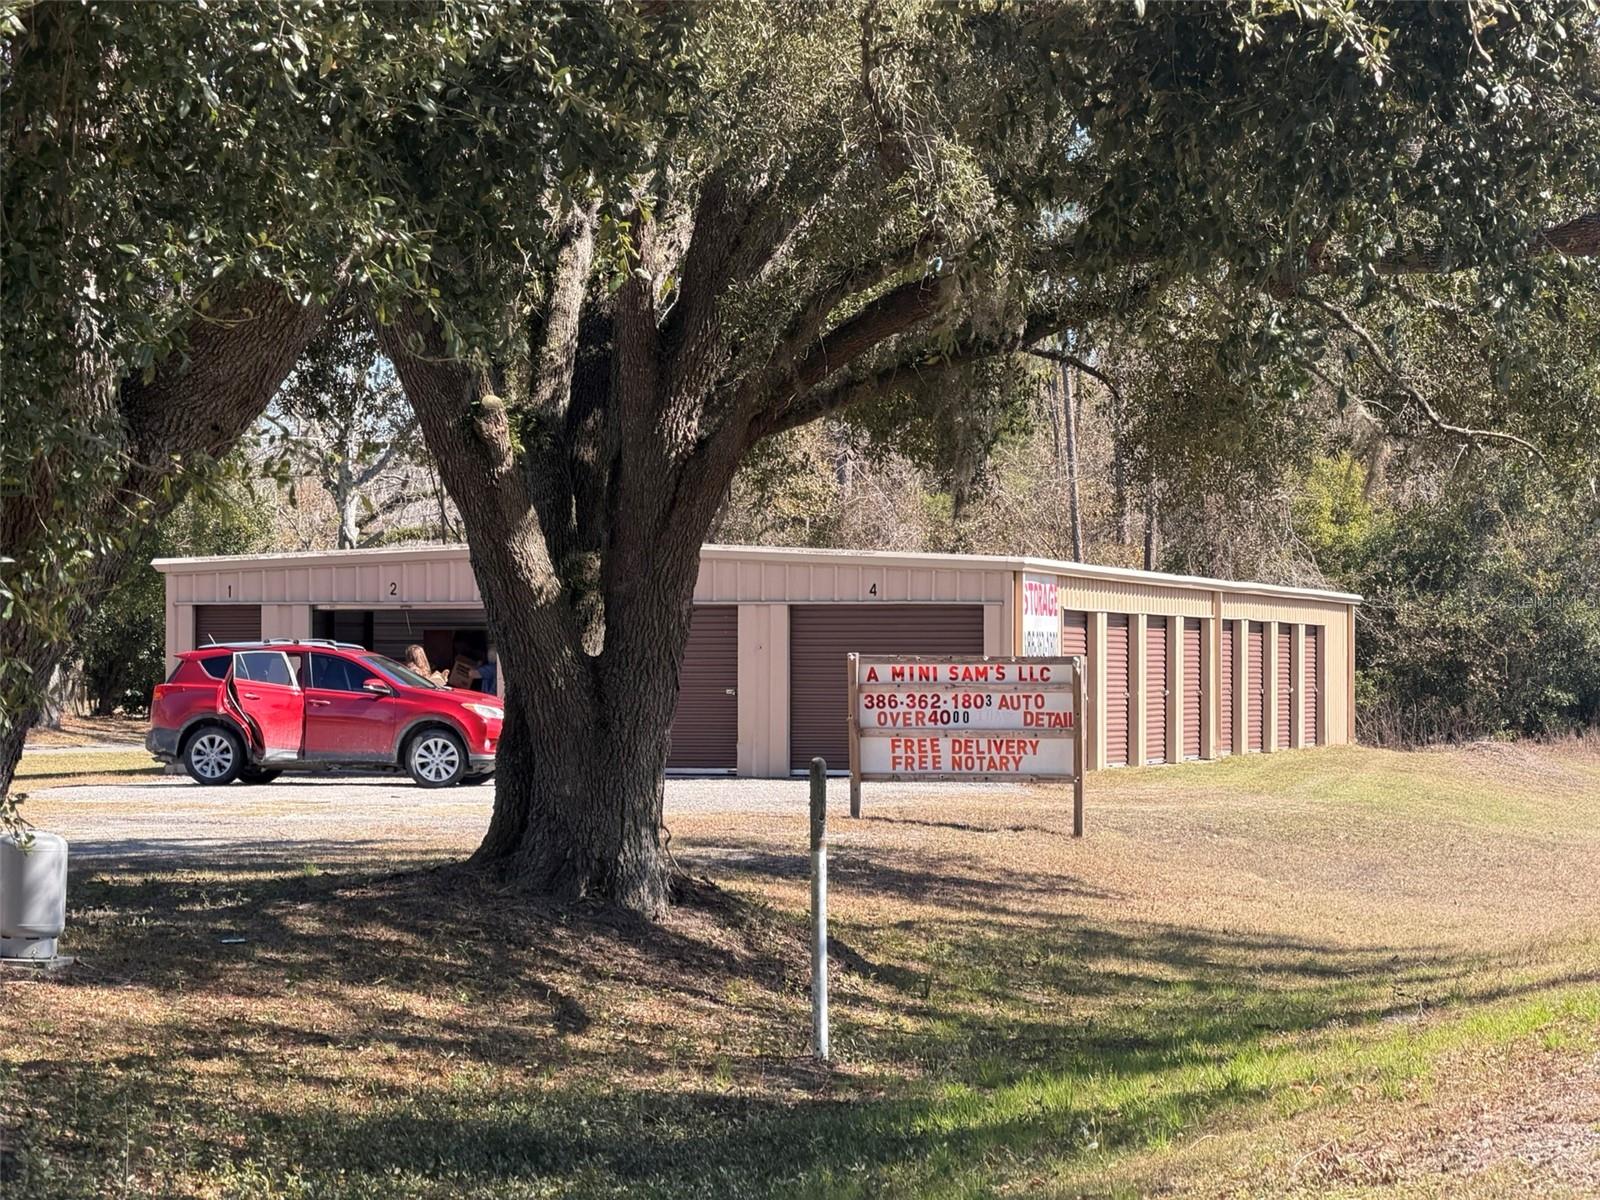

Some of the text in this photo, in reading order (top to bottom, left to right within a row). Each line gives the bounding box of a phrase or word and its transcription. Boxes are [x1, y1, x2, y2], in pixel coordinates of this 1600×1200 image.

[227, 585, 233, 599] 1
[389, 582, 397, 596] 2
[868, 583, 878, 597] 4
[1024, 583, 1058, 617] STORAGE
[866, 664, 1051, 682] A MINI SAM'S LLC
[998, 694, 1045, 711] AUTO
[1023, 712, 1073, 729] DETAIL
[891, 738, 1040, 756] FREE DELIVERY
[892, 755, 1024, 771] FREE NOTARY
